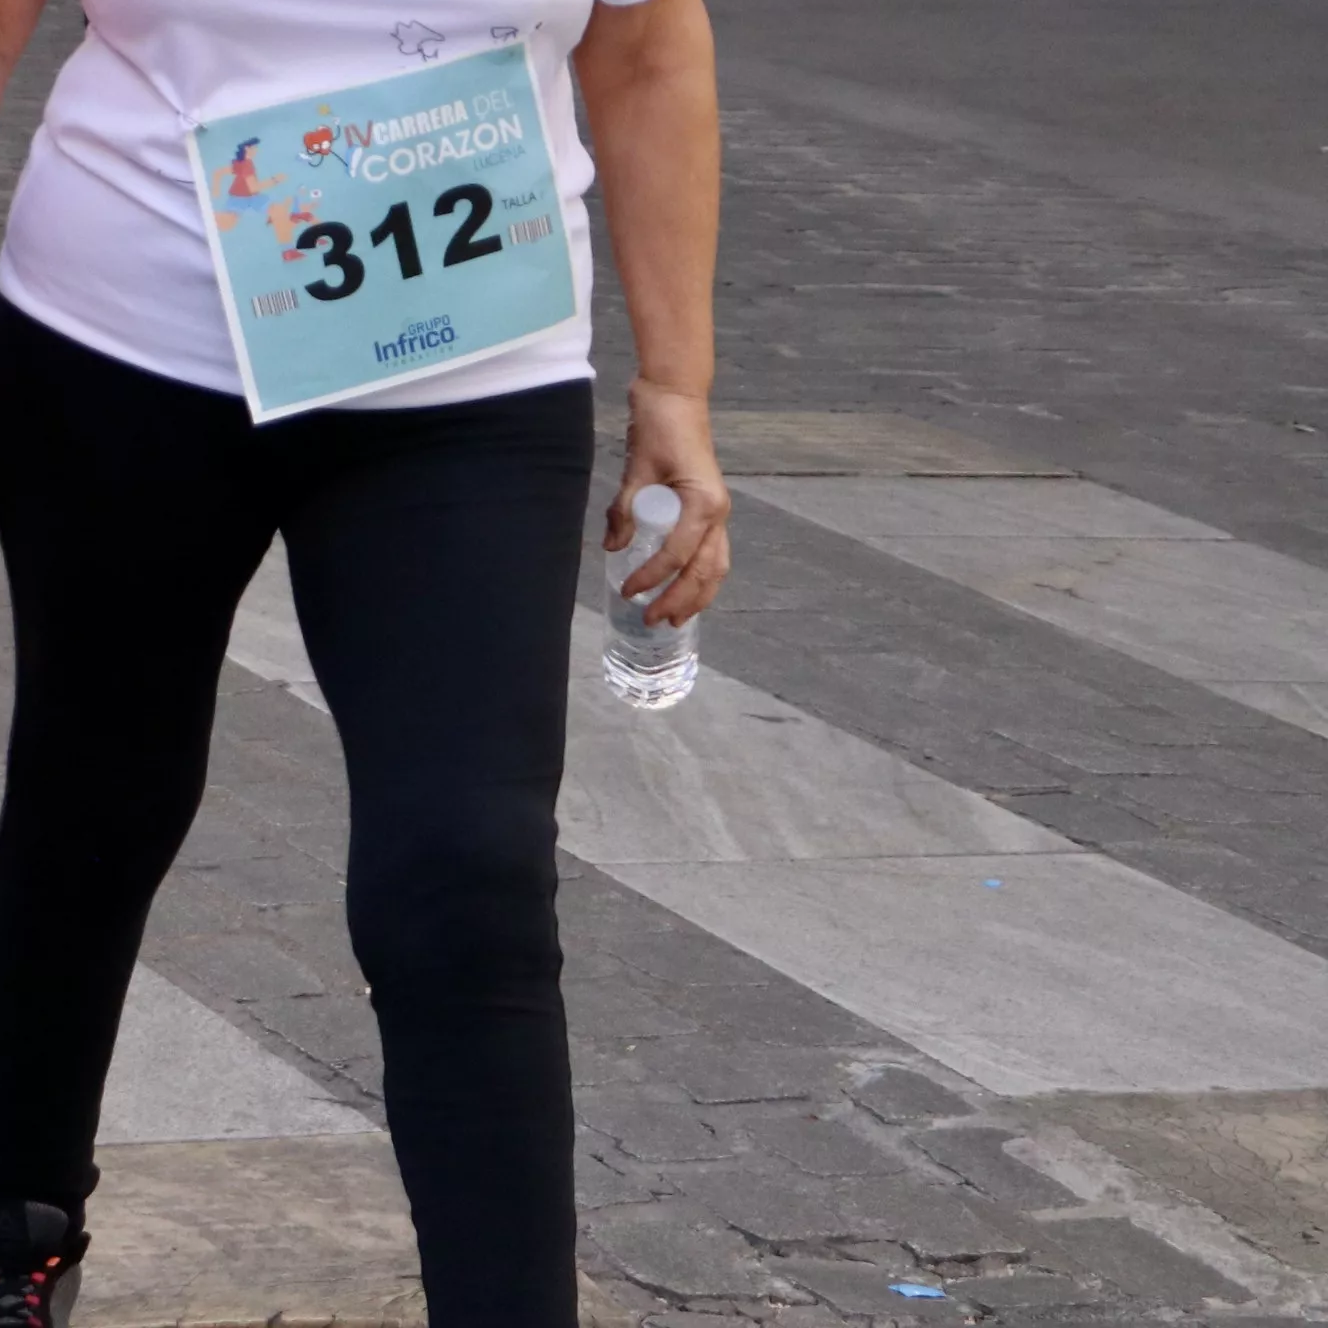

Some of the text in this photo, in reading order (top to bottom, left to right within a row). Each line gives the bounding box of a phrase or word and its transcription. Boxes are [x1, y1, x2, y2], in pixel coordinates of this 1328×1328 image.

[344, 88, 514, 148] IV CARRERA DEL
[362, 114, 524, 183] CORAZON
[501, 192, 537, 210] TALLA
[295, 183, 504, 302] 312
[373, 326, 456, 363] Infrico
[407, 314, 451, 335] GRUPO
